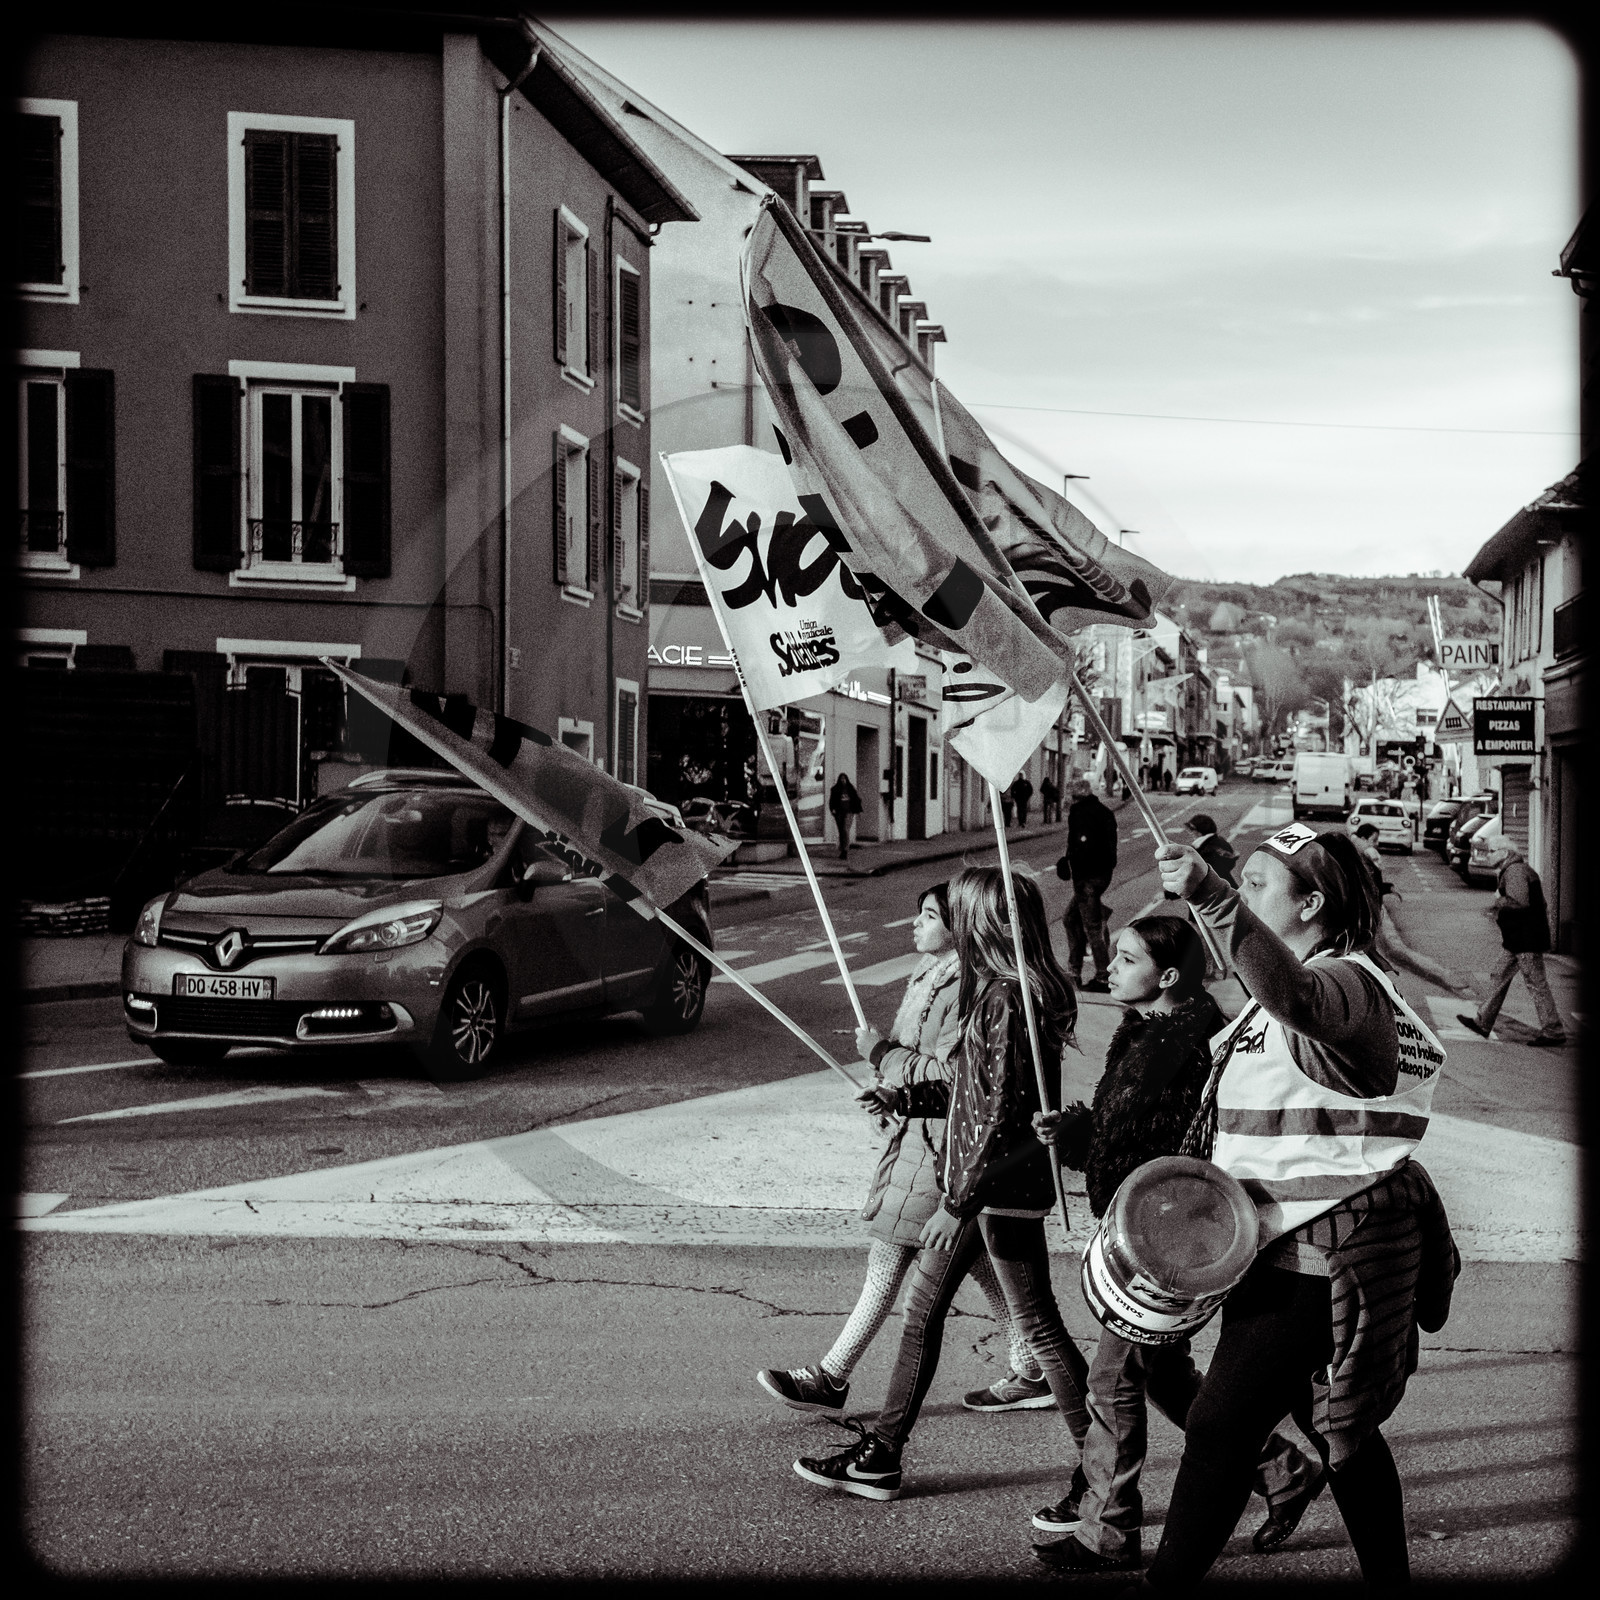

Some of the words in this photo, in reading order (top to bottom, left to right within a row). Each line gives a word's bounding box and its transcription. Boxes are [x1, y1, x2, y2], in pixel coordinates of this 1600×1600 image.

[1441, 644, 1489, 664] PAIN
[1475, 700, 1533, 711] RESTAURANT
[1488, 720, 1521, 731] PIZZAS
[1484, 740, 1534, 750] EMPORTER
